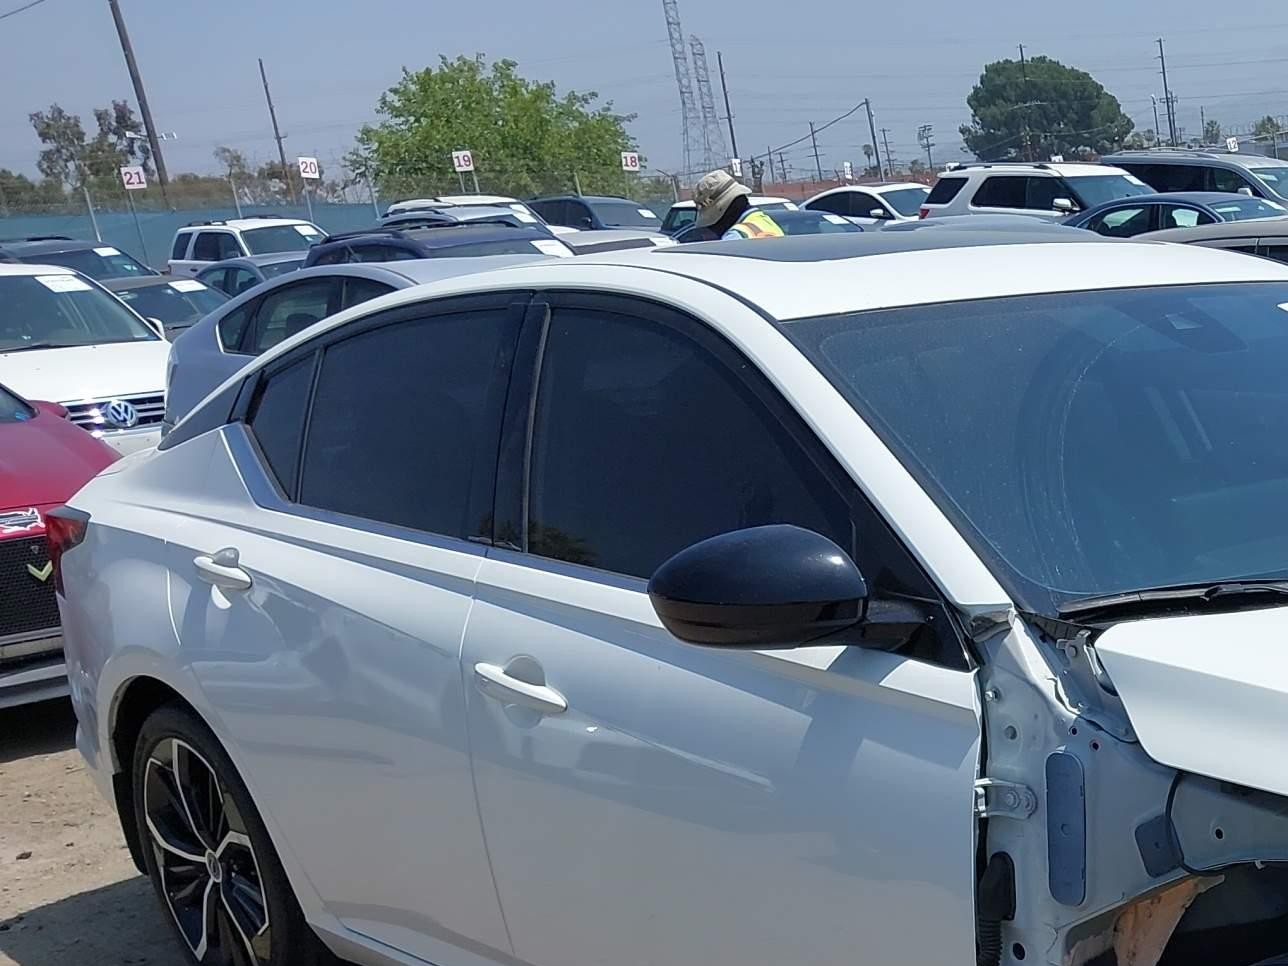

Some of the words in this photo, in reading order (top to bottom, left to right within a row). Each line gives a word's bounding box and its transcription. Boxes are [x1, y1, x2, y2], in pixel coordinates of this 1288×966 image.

[300, 160, 318, 175] 20
[454, 154, 472, 168] 19
[623, 155, 638, 167] 18
[123, 171, 145, 186] 21
